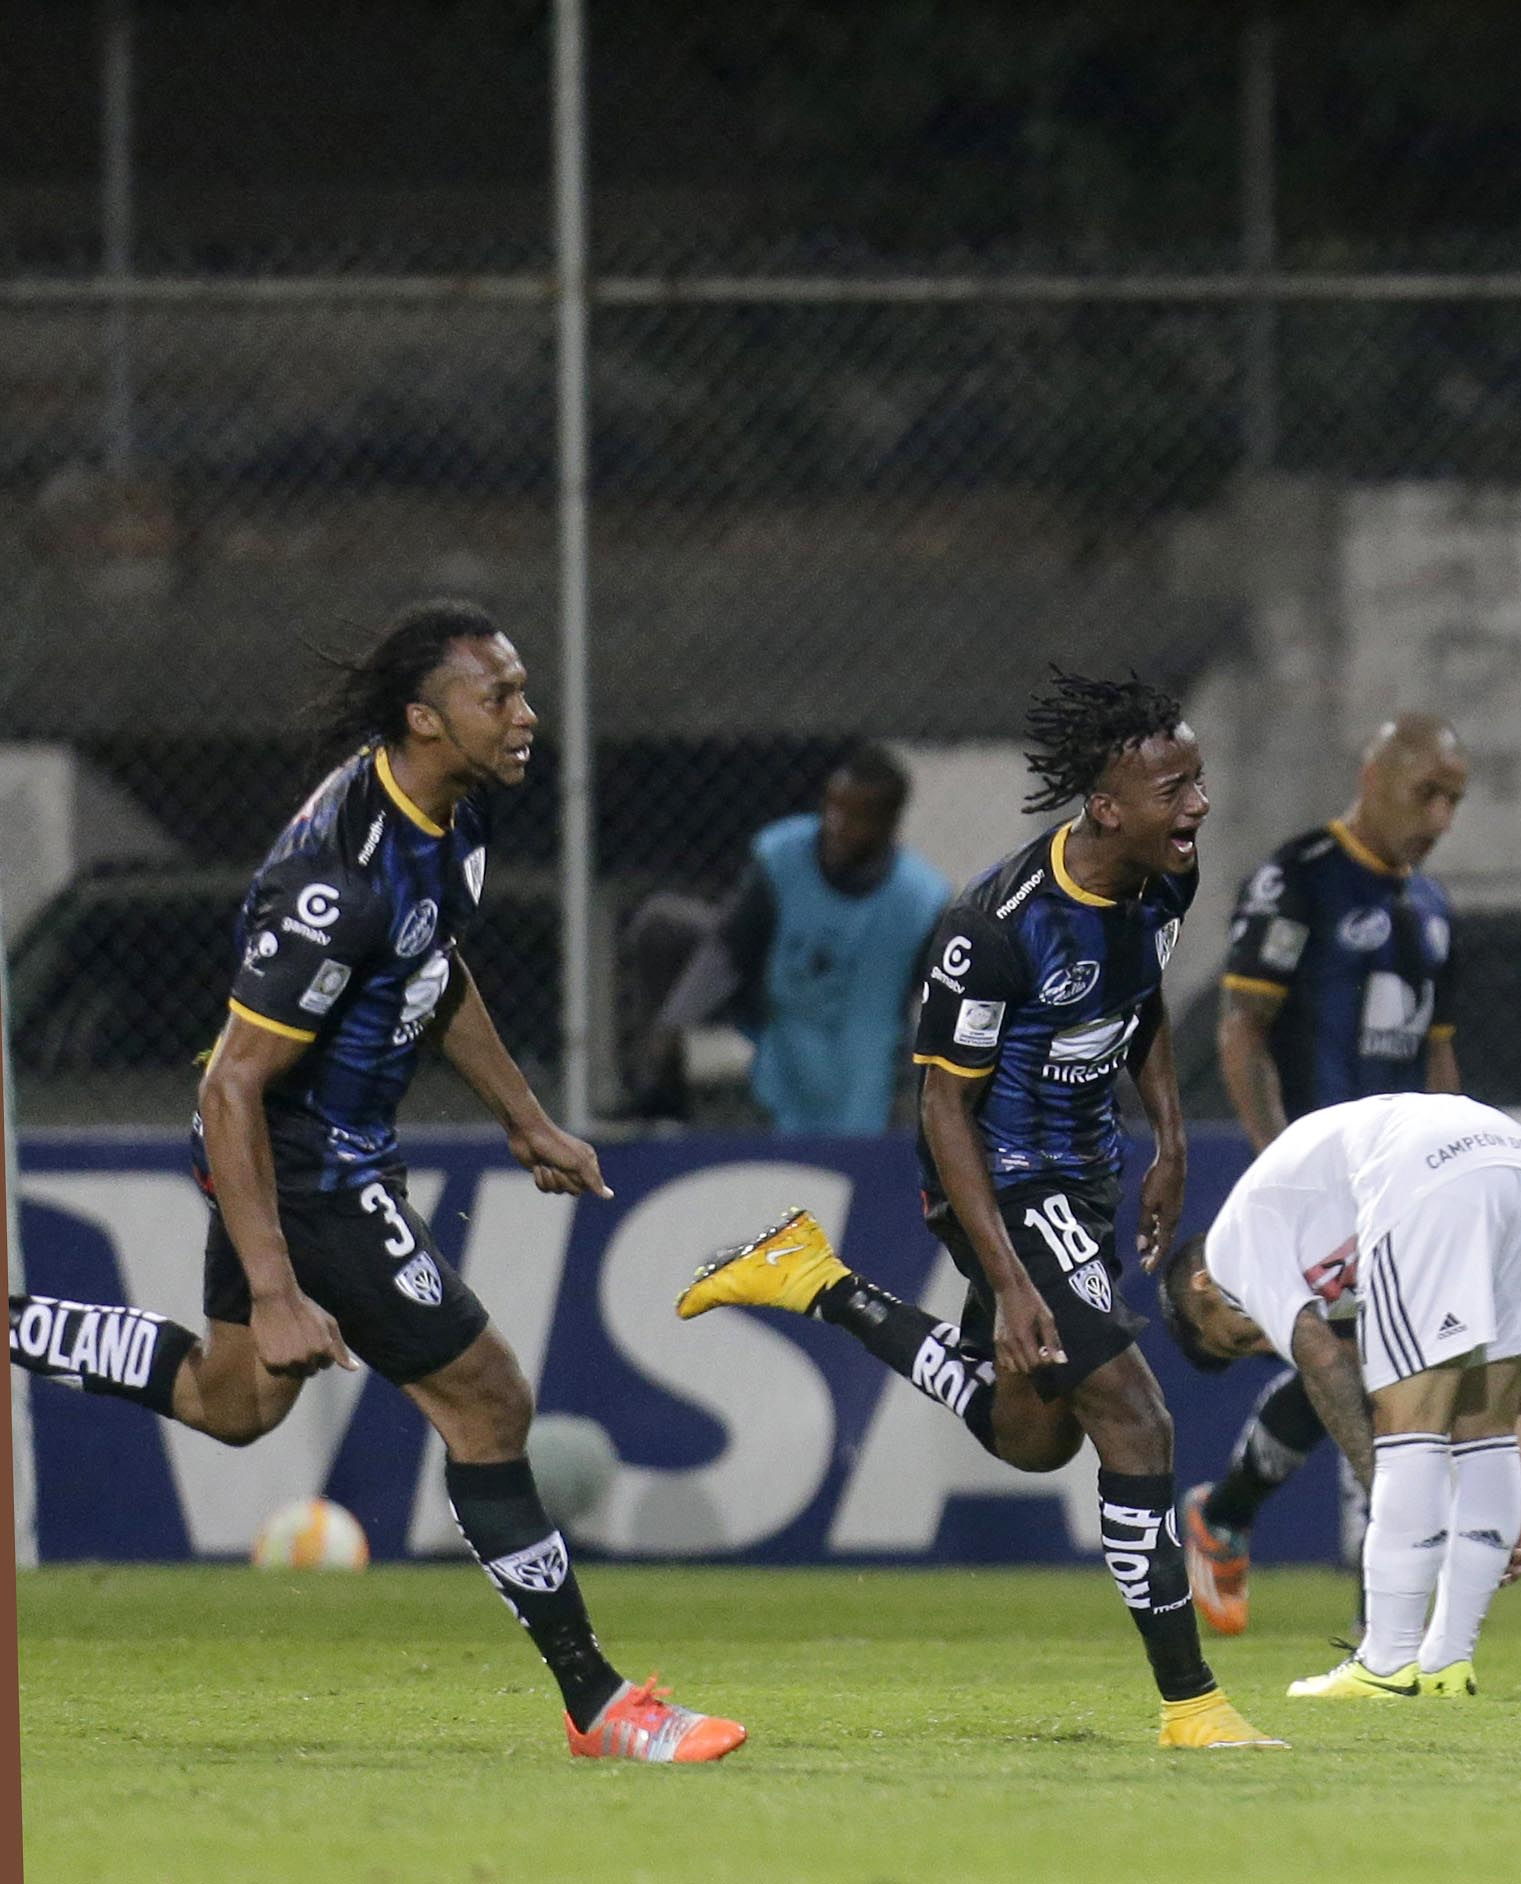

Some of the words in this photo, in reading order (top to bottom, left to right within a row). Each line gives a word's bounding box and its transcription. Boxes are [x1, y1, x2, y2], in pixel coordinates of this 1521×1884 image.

[361, 1182, 416, 1257] 3
[1024, 1193, 1100, 1272] 18
[14, 1160, 1112, 1557] VISA
